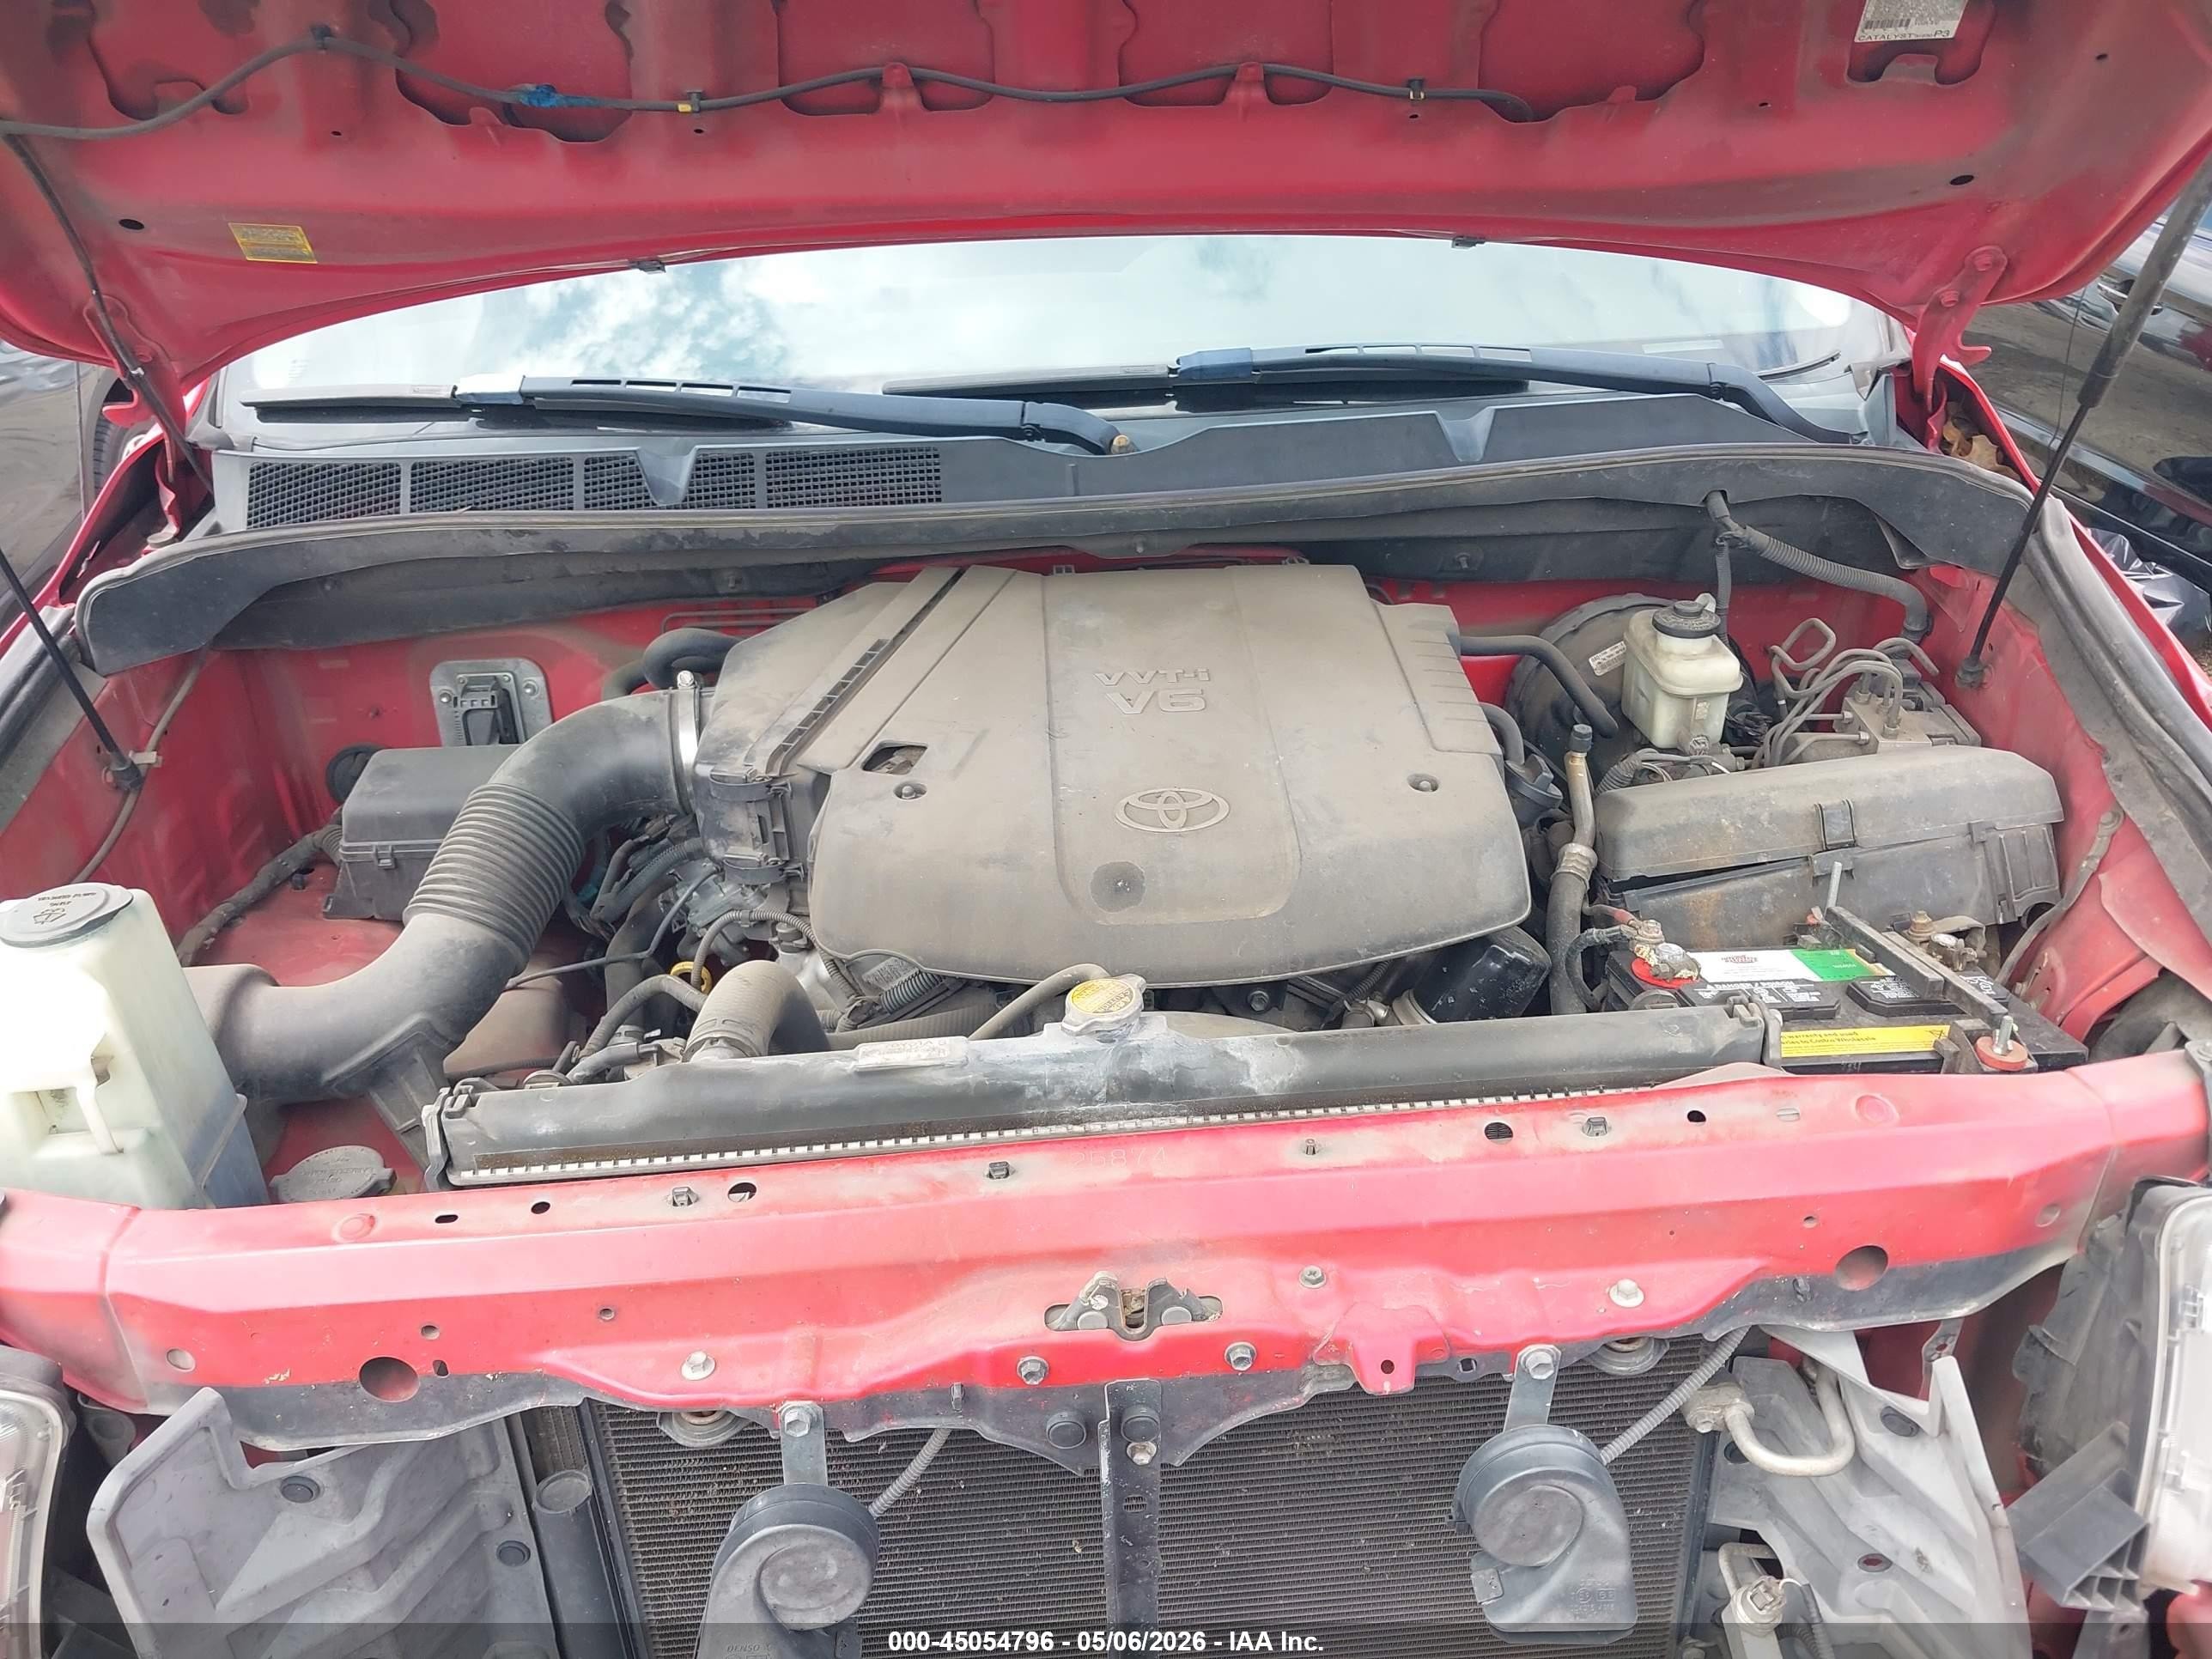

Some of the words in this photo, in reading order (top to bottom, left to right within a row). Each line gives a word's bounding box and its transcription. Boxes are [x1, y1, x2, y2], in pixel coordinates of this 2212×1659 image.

[1858, 33, 1915, 42] CATALYST
[1934, 29, 1951, 38] P3
[1105, 688, 1207, 715] V6
